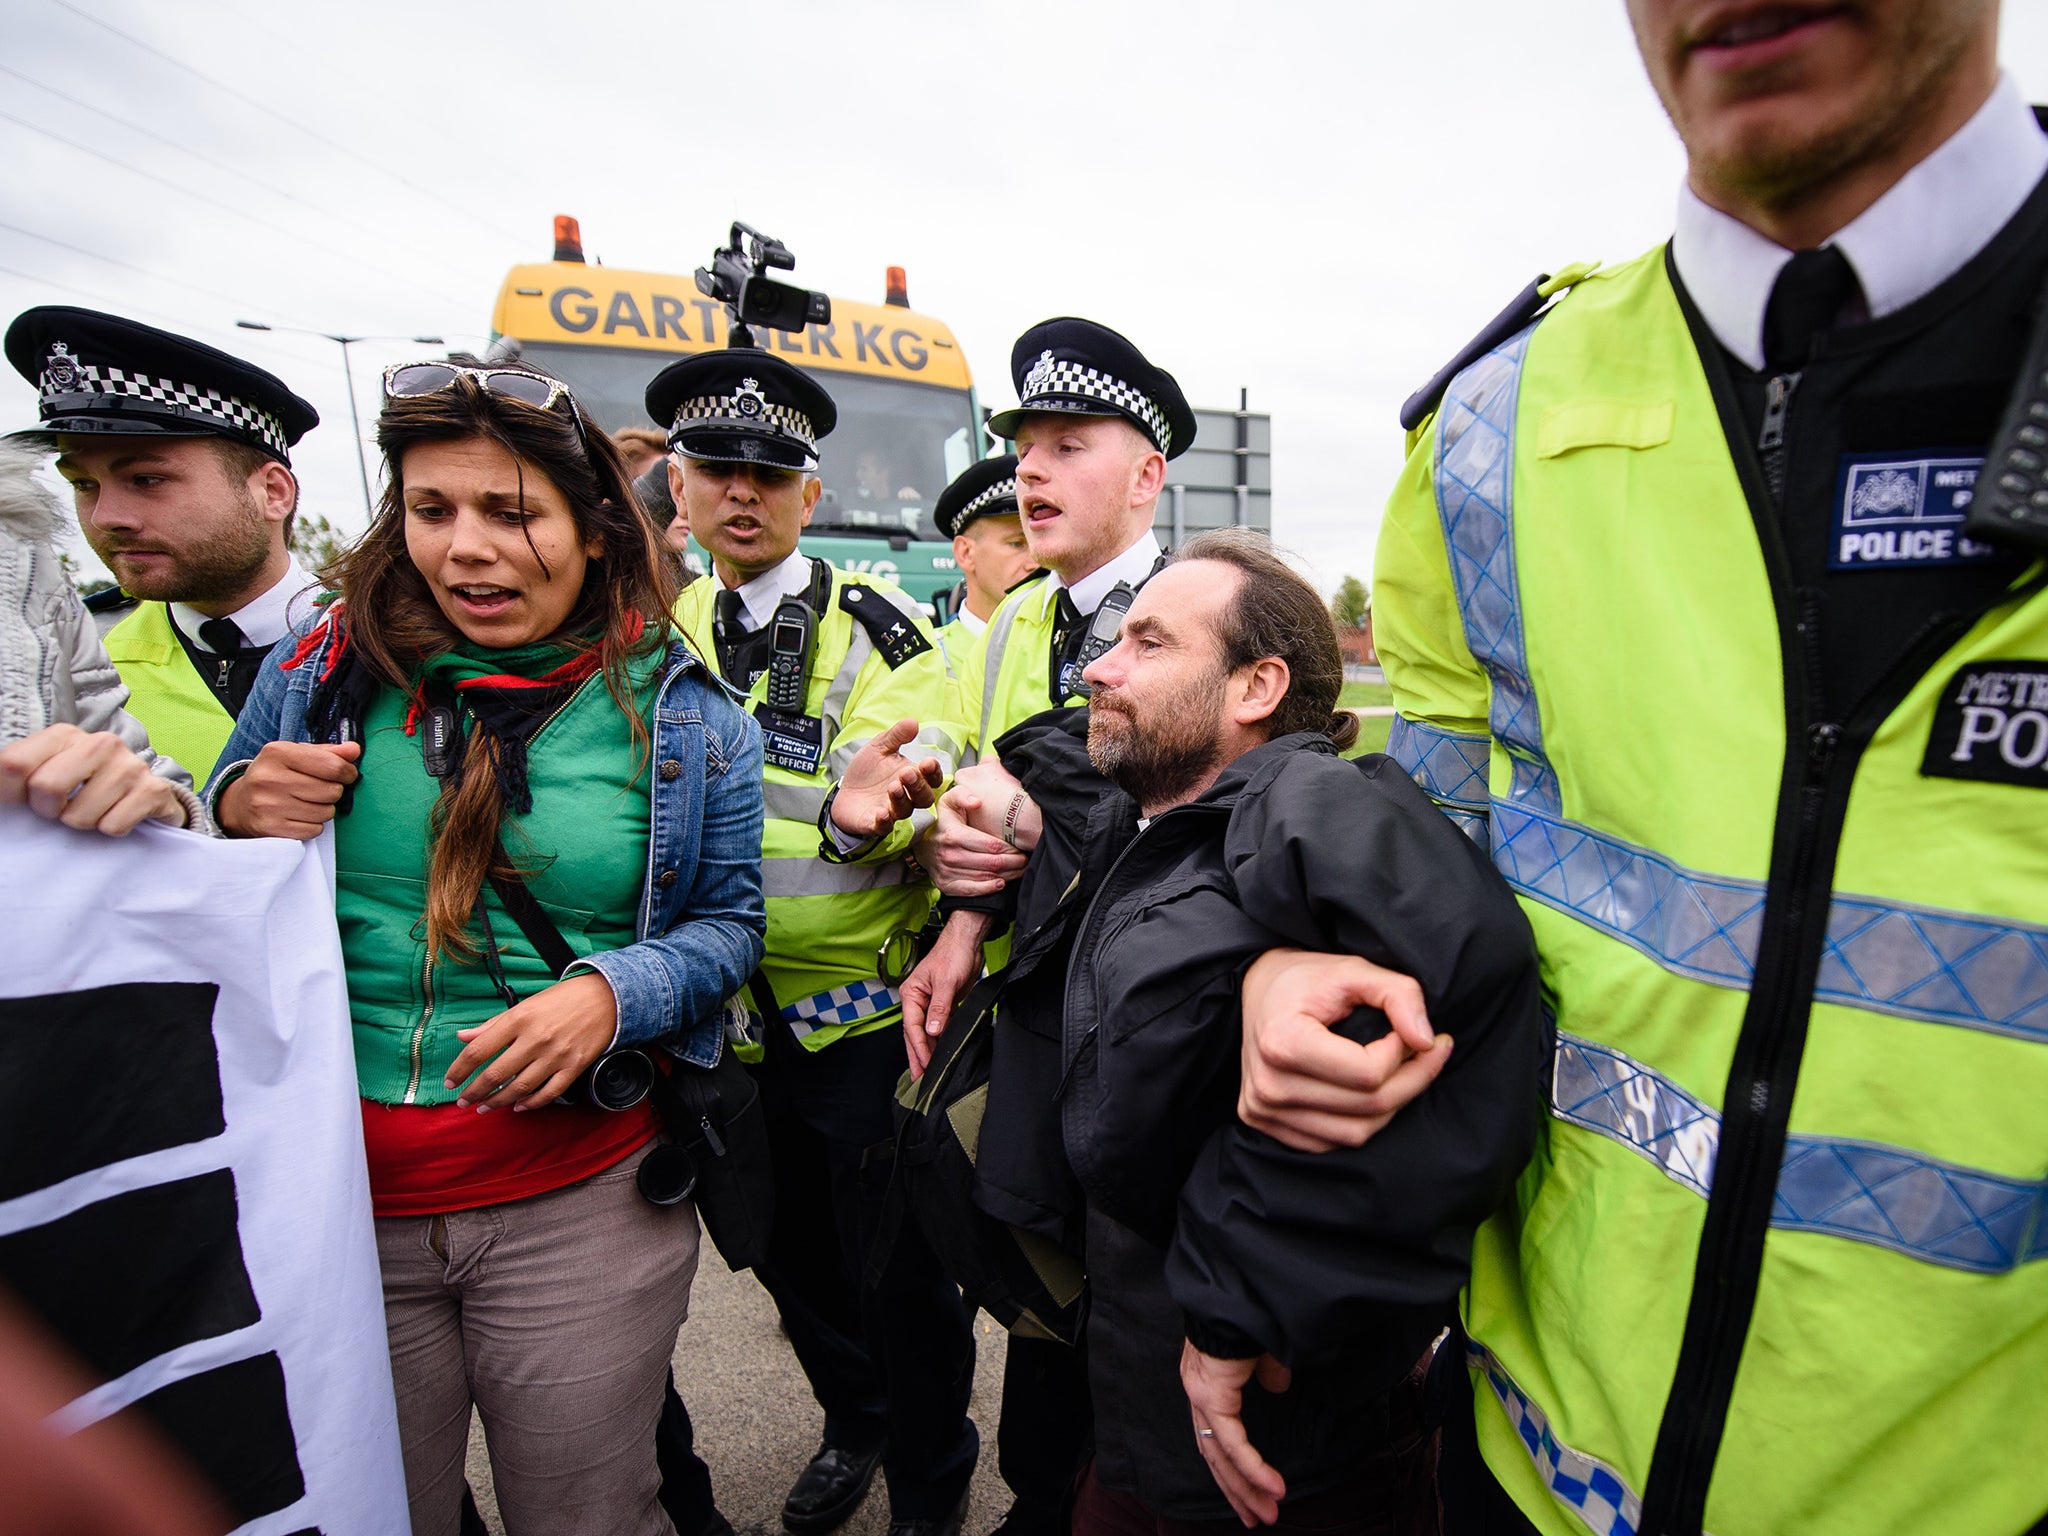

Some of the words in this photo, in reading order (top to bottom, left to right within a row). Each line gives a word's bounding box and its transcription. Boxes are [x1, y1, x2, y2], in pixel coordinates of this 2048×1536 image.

[853, 321, 928, 371] KG
[1839, 529, 1954, 563] POLICE
[892, 634, 921, 661] 347
[774, 735, 816, 751] METROPOLITAN
[777, 743, 808, 755] POLICE
[1950, 705, 2048, 771] PO
[778, 756, 815, 772] OFFICER
[1005, 792, 1025, 829] MADNESS
